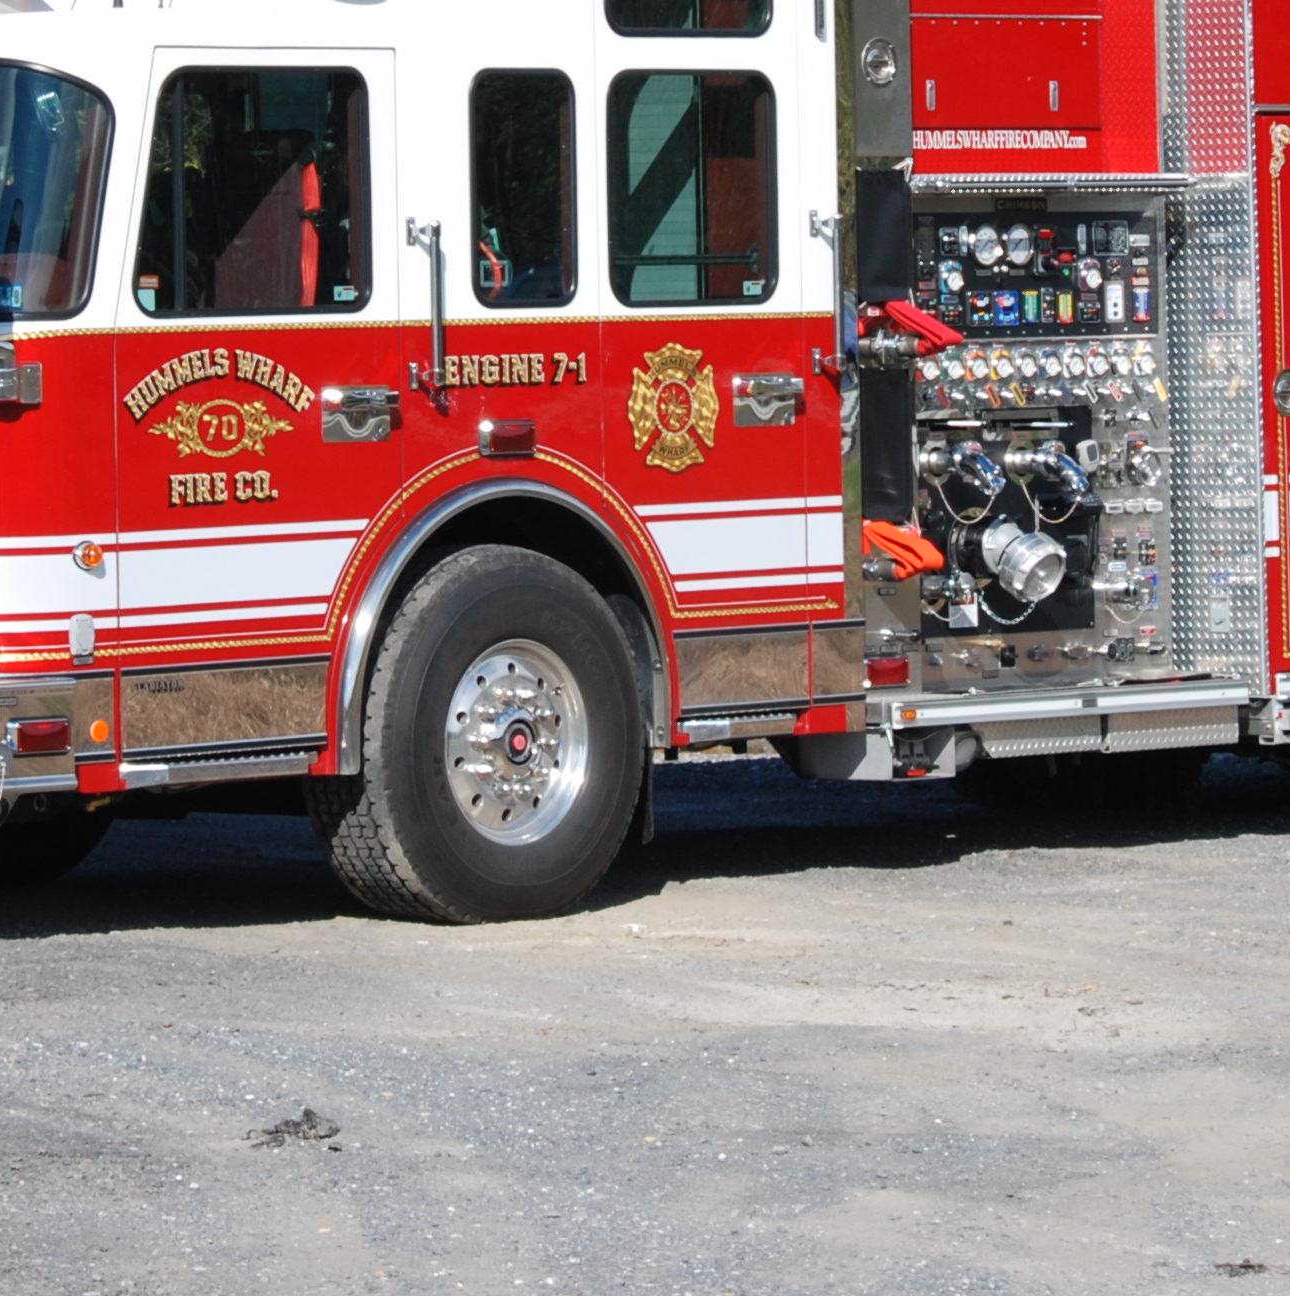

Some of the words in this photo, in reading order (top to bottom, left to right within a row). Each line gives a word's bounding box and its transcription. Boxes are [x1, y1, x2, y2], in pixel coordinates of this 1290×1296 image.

[122, 347, 230, 422] HUMMELS
[235, 349, 315, 413] WHARF
[444, 353, 545, 386] ENGINE
[552, 352, 587, 384] 7-1
[202, 414, 238, 441] 70
[168, 472, 228, 505] FIRE
[234, 470, 279, 500] CO.
